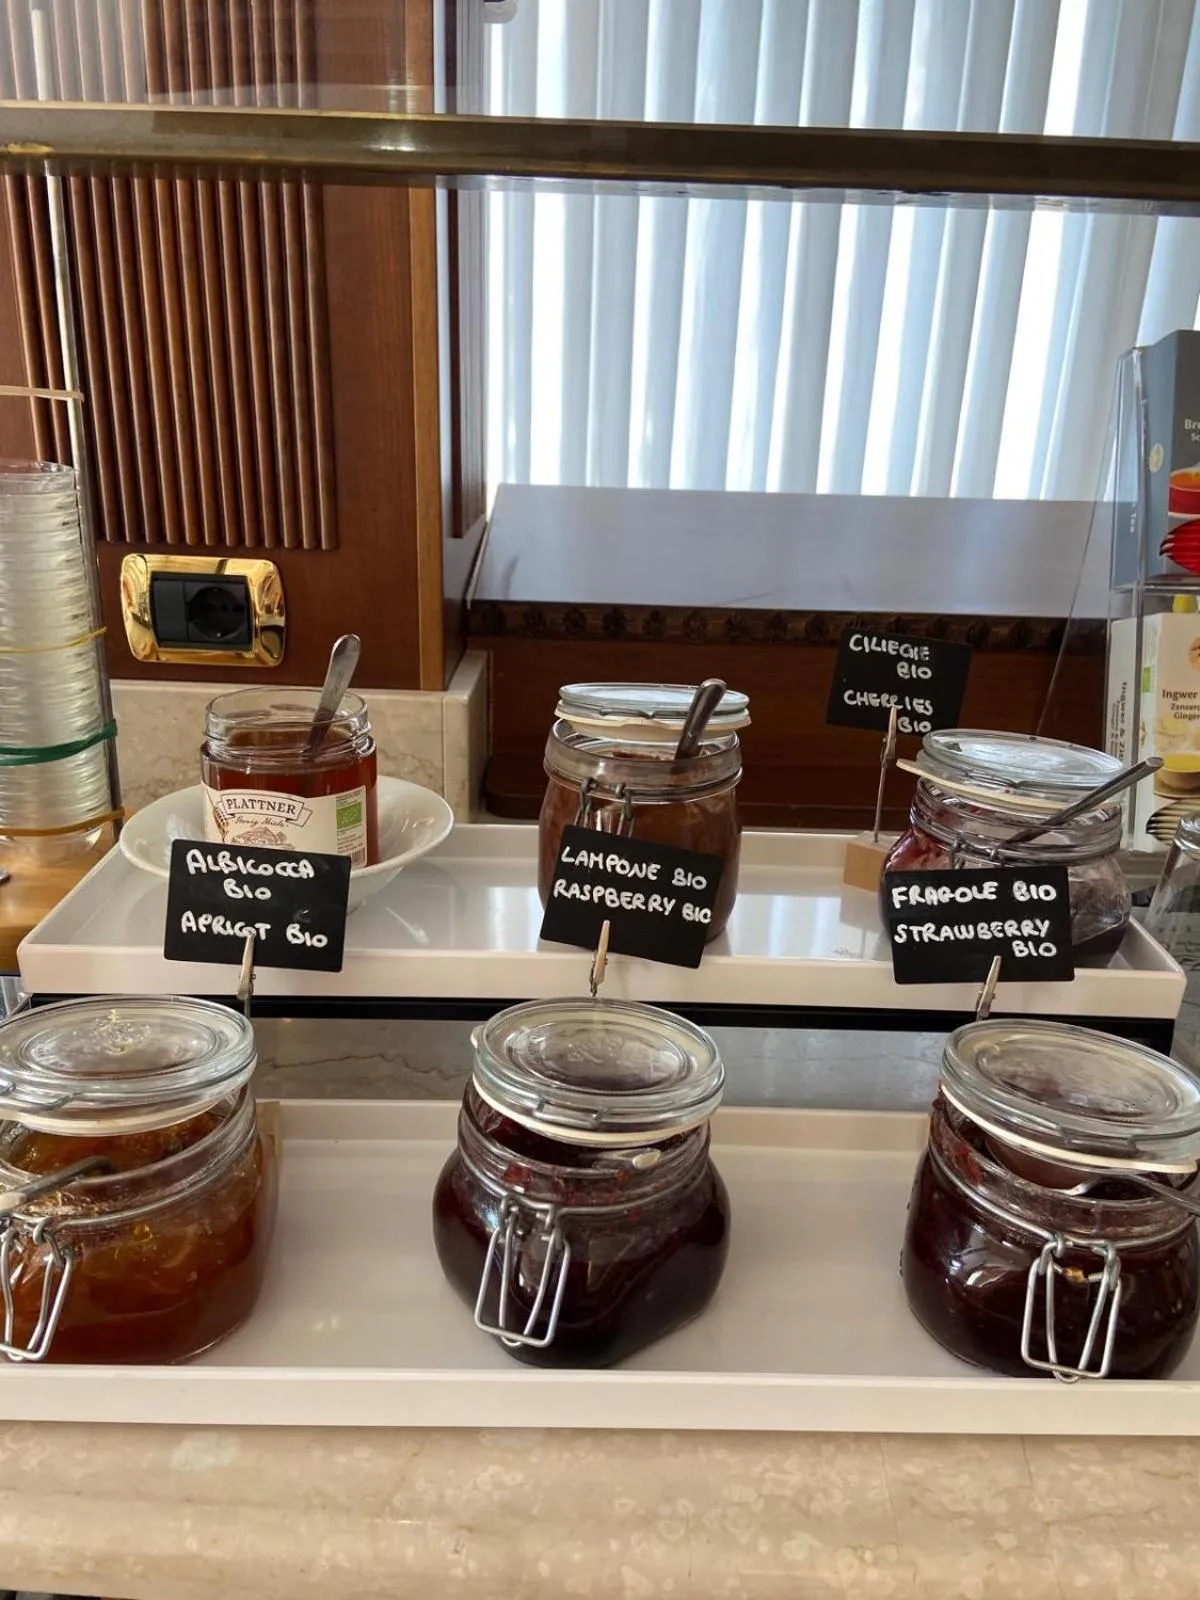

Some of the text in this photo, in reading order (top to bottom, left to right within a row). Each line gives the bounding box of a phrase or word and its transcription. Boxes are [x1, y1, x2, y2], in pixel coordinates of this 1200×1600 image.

[849, 634, 930, 661] CILIEGIE
[897, 661, 932, 679] BIO
[844, 690, 933, 715] CHERRIES
[1162, 689, 1198, 702] Ingwer
[898, 716, 932, 733] BIO
[226, 799, 296, 815] PLATTNER
[186, 849, 315, 879] ALBICOCCA
[561, 846, 707, 890] LAMPONE BIO
[223, 878, 272, 900] BIO
[892, 880, 1057, 909] FRAGOLE BIO
[553, 879, 712, 924] RASPBERRY BIO
[181, 910, 328, 948] APRICOT BIO
[894, 919, 1050, 943] STRAWBERRY
[1012, 940, 1057, 957] BIO
